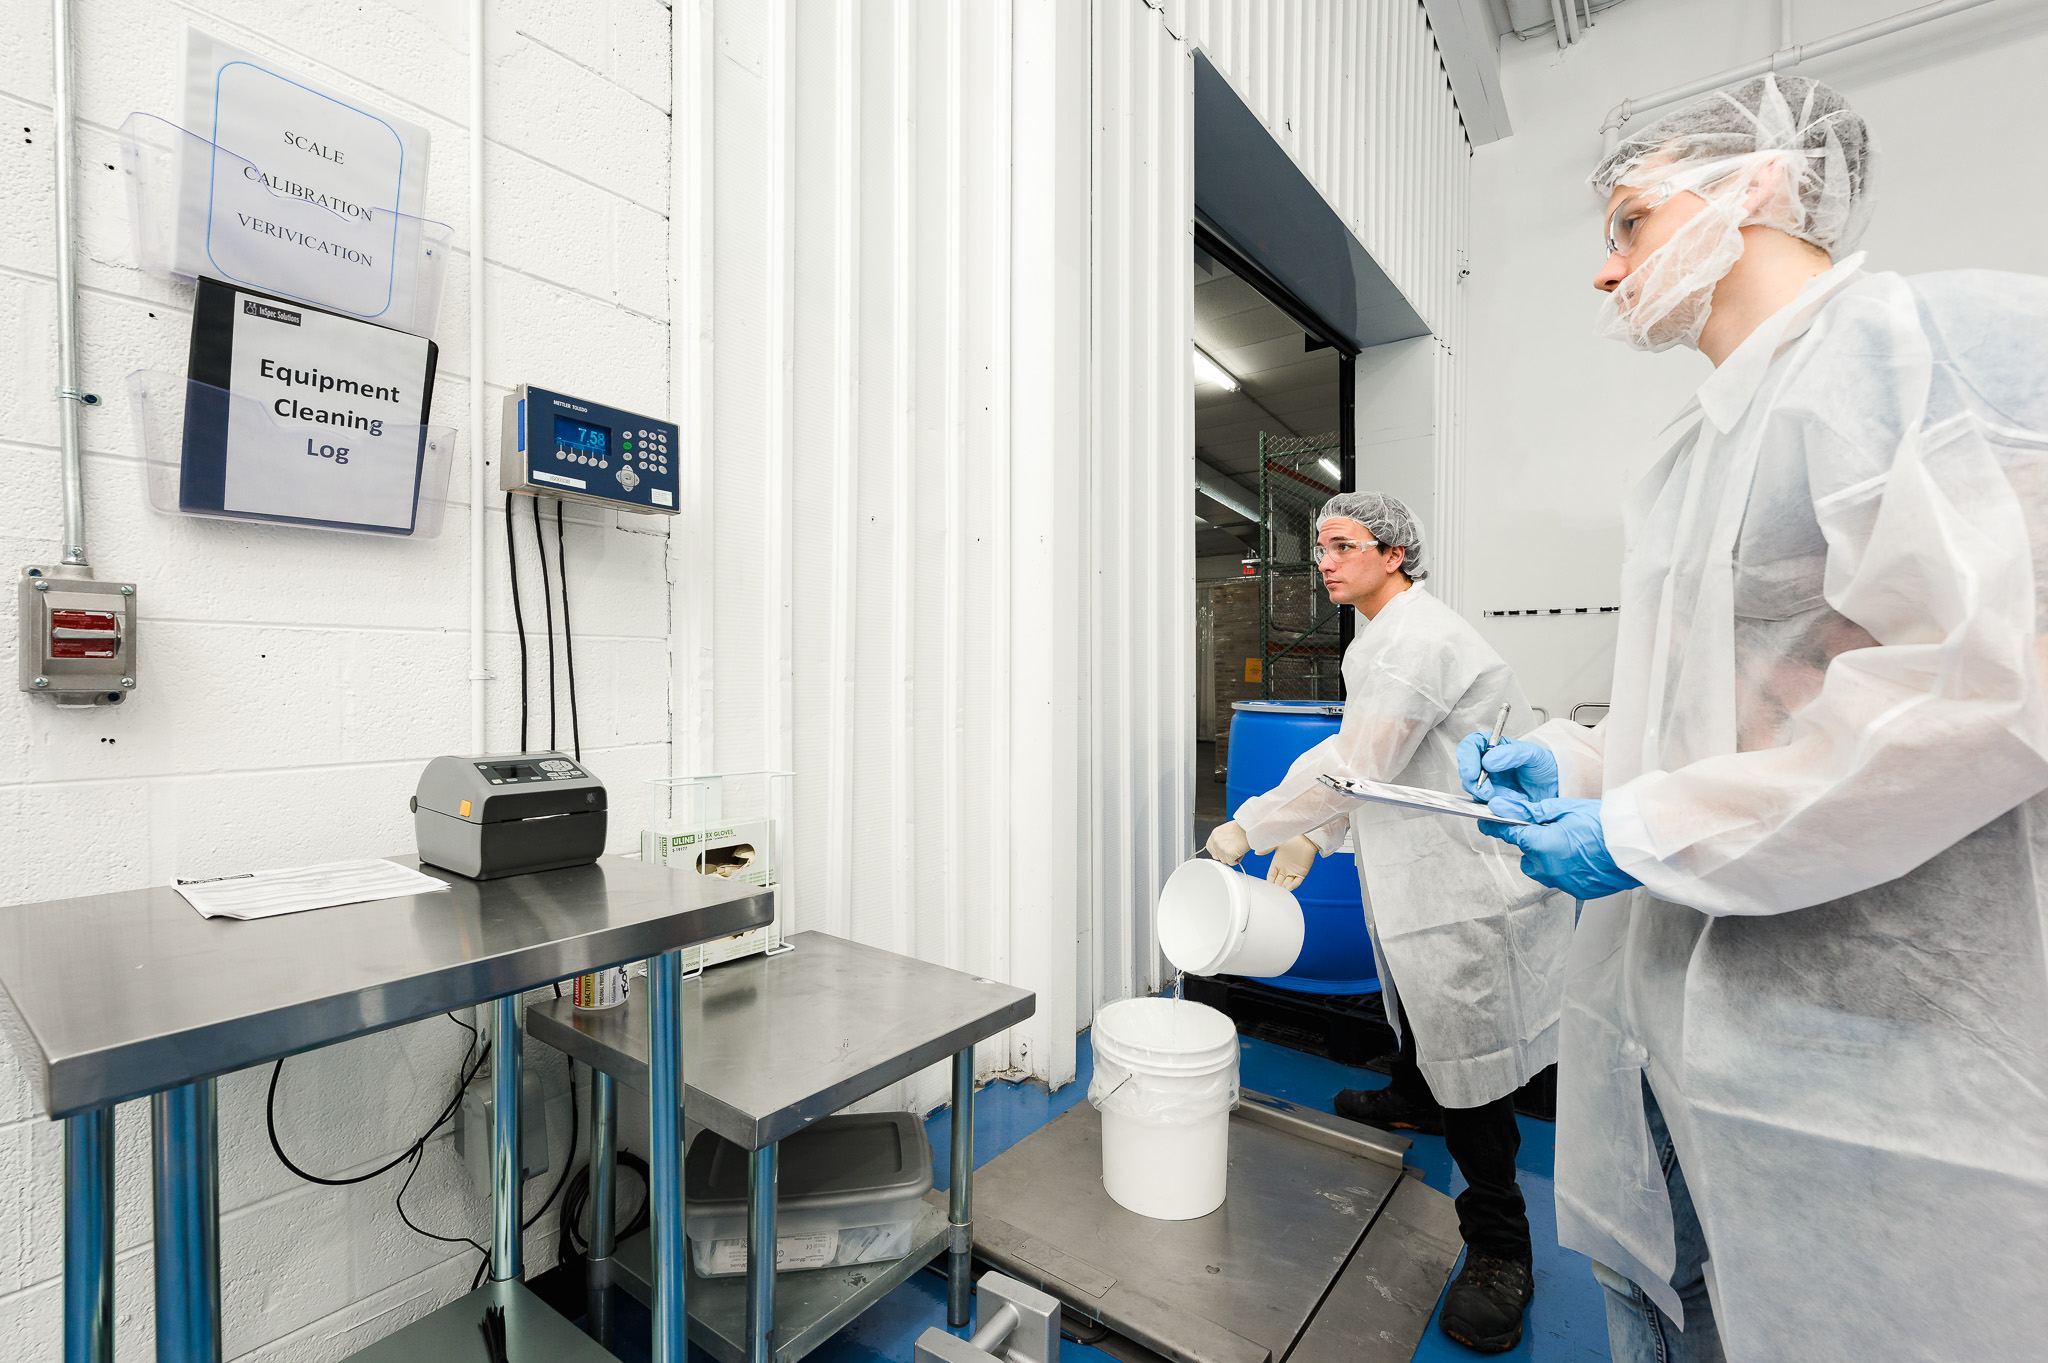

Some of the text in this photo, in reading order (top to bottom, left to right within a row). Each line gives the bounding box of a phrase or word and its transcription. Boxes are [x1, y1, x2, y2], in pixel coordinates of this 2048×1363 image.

[284, 131, 345, 166] SCALE
[243, 166, 374, 222] CALIBRATION
[237, 212, 373, 267] VERIVICATION
[259, 306, 300, 324] InSpec Solutions
[260, 358, 400, 403] Equipment
[274, 398, 384, 437] Cleaning
[553, 399, 588, 413] METTLER TOLEDO
[307, 438, 350, 465] Log
[578, 427, 606, 447] 7.58
[673, 835, 695, 846] ULINE
[697, 832, 713, 840] LAEX
[713, 829, 734, 837] GLOVES
[584, 974, 592, 1007] REACTIVITY
